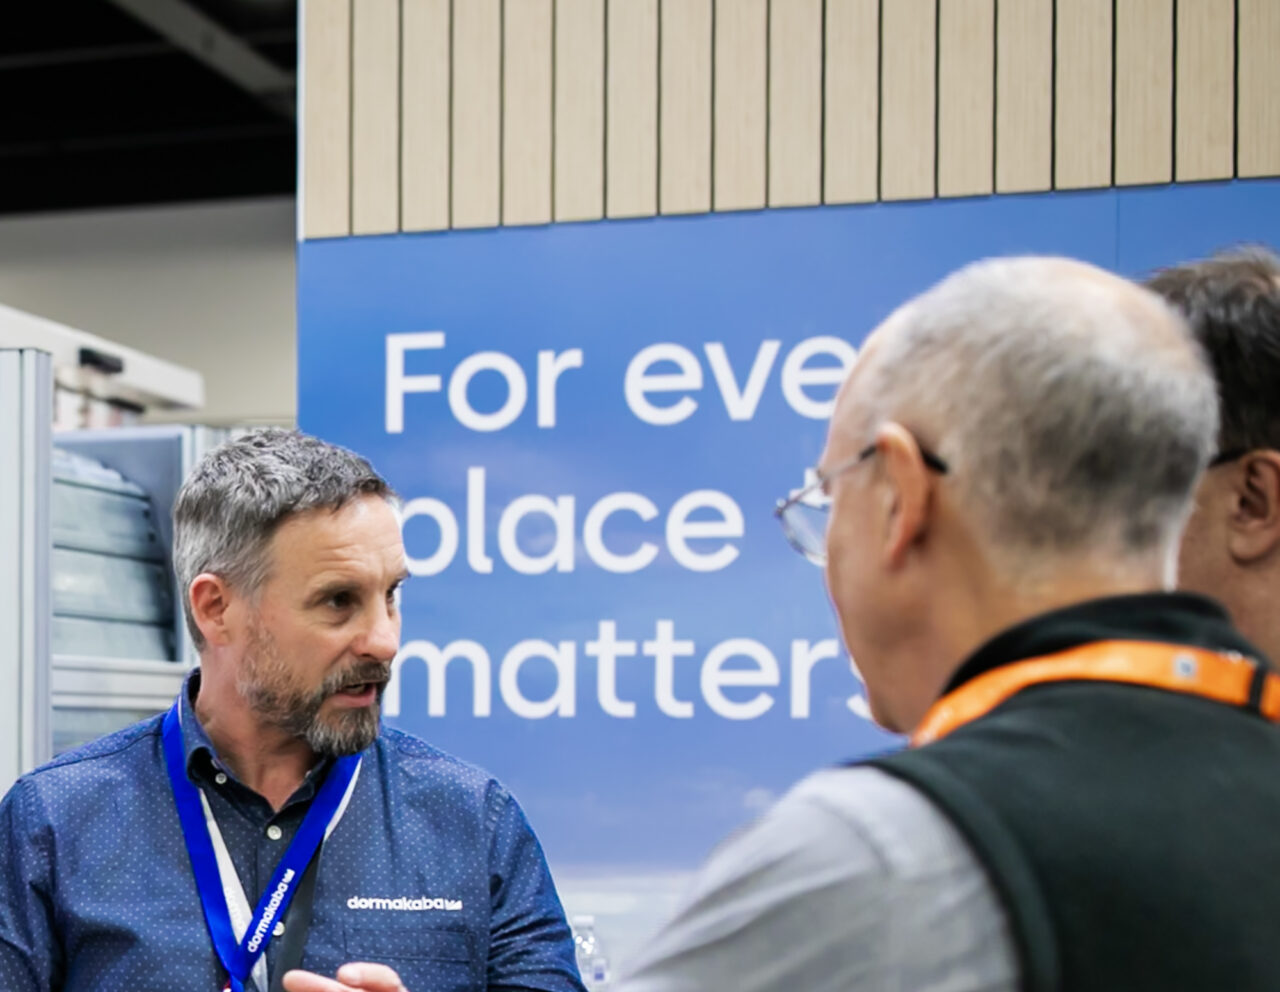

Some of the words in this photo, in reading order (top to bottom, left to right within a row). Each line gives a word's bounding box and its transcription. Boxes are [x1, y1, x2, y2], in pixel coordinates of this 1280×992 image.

[385, 331, 583, 434] For
[624, 335, 858, 426] eve
[247, 881, 289, 953] dormakaba
[347, 895, 445, 911] dormakaba
